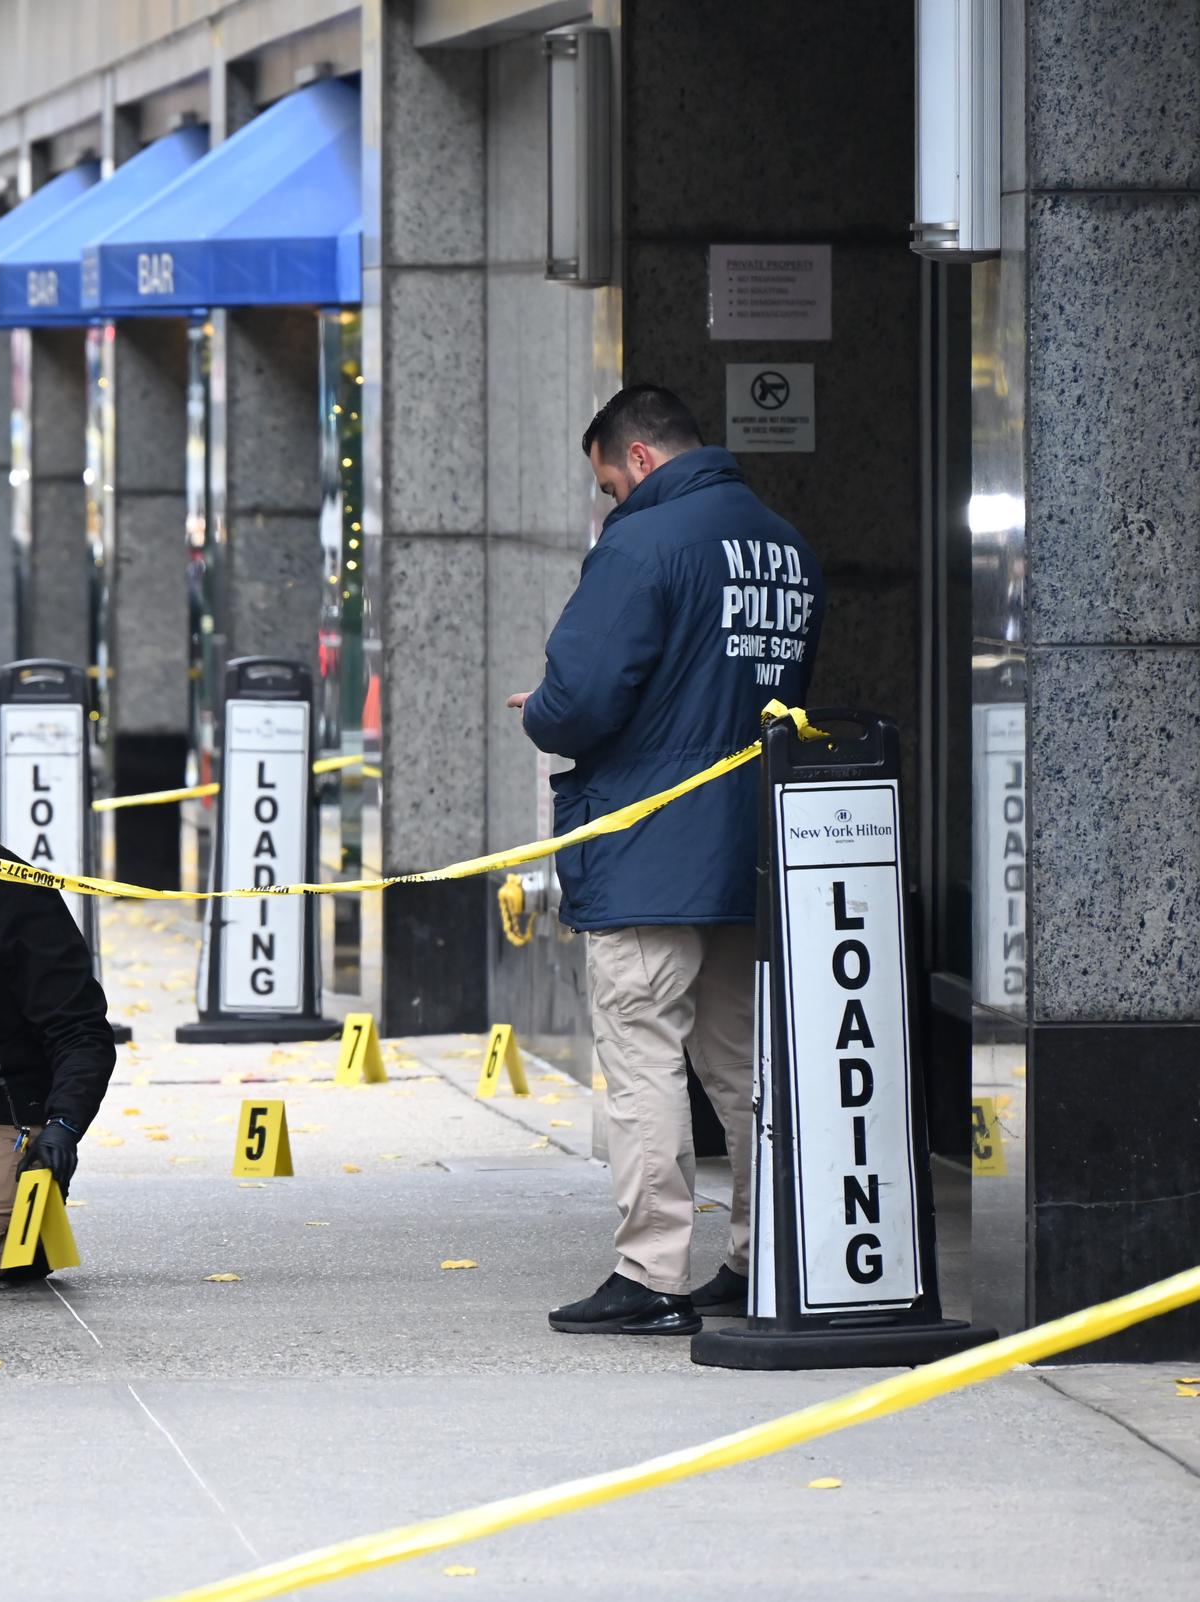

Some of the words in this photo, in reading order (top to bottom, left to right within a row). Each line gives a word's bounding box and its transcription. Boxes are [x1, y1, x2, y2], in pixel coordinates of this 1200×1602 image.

[28, 271, 58, 307] BAR
[138, 254, 174, 294] BAR
[722, 539, 809, 586] N.Y.P.D.
[721, 585, 814, 634] POLICE
[726, 634, 766, 658] CRIME
[790, 827, 820, 840] New
[824, 824, 853, 838] York
[856, 824, 892, 836] Hilton
[250, 761, 279, 996] LOADING
[349, 1025, 362, 1070] 7
[485, 1033, 502, 1080] 6
[832, 881, 884, 1285] LOADING
[245, 1107, 268, 1161] 5
[20, 1182, 40, 1246] 1
